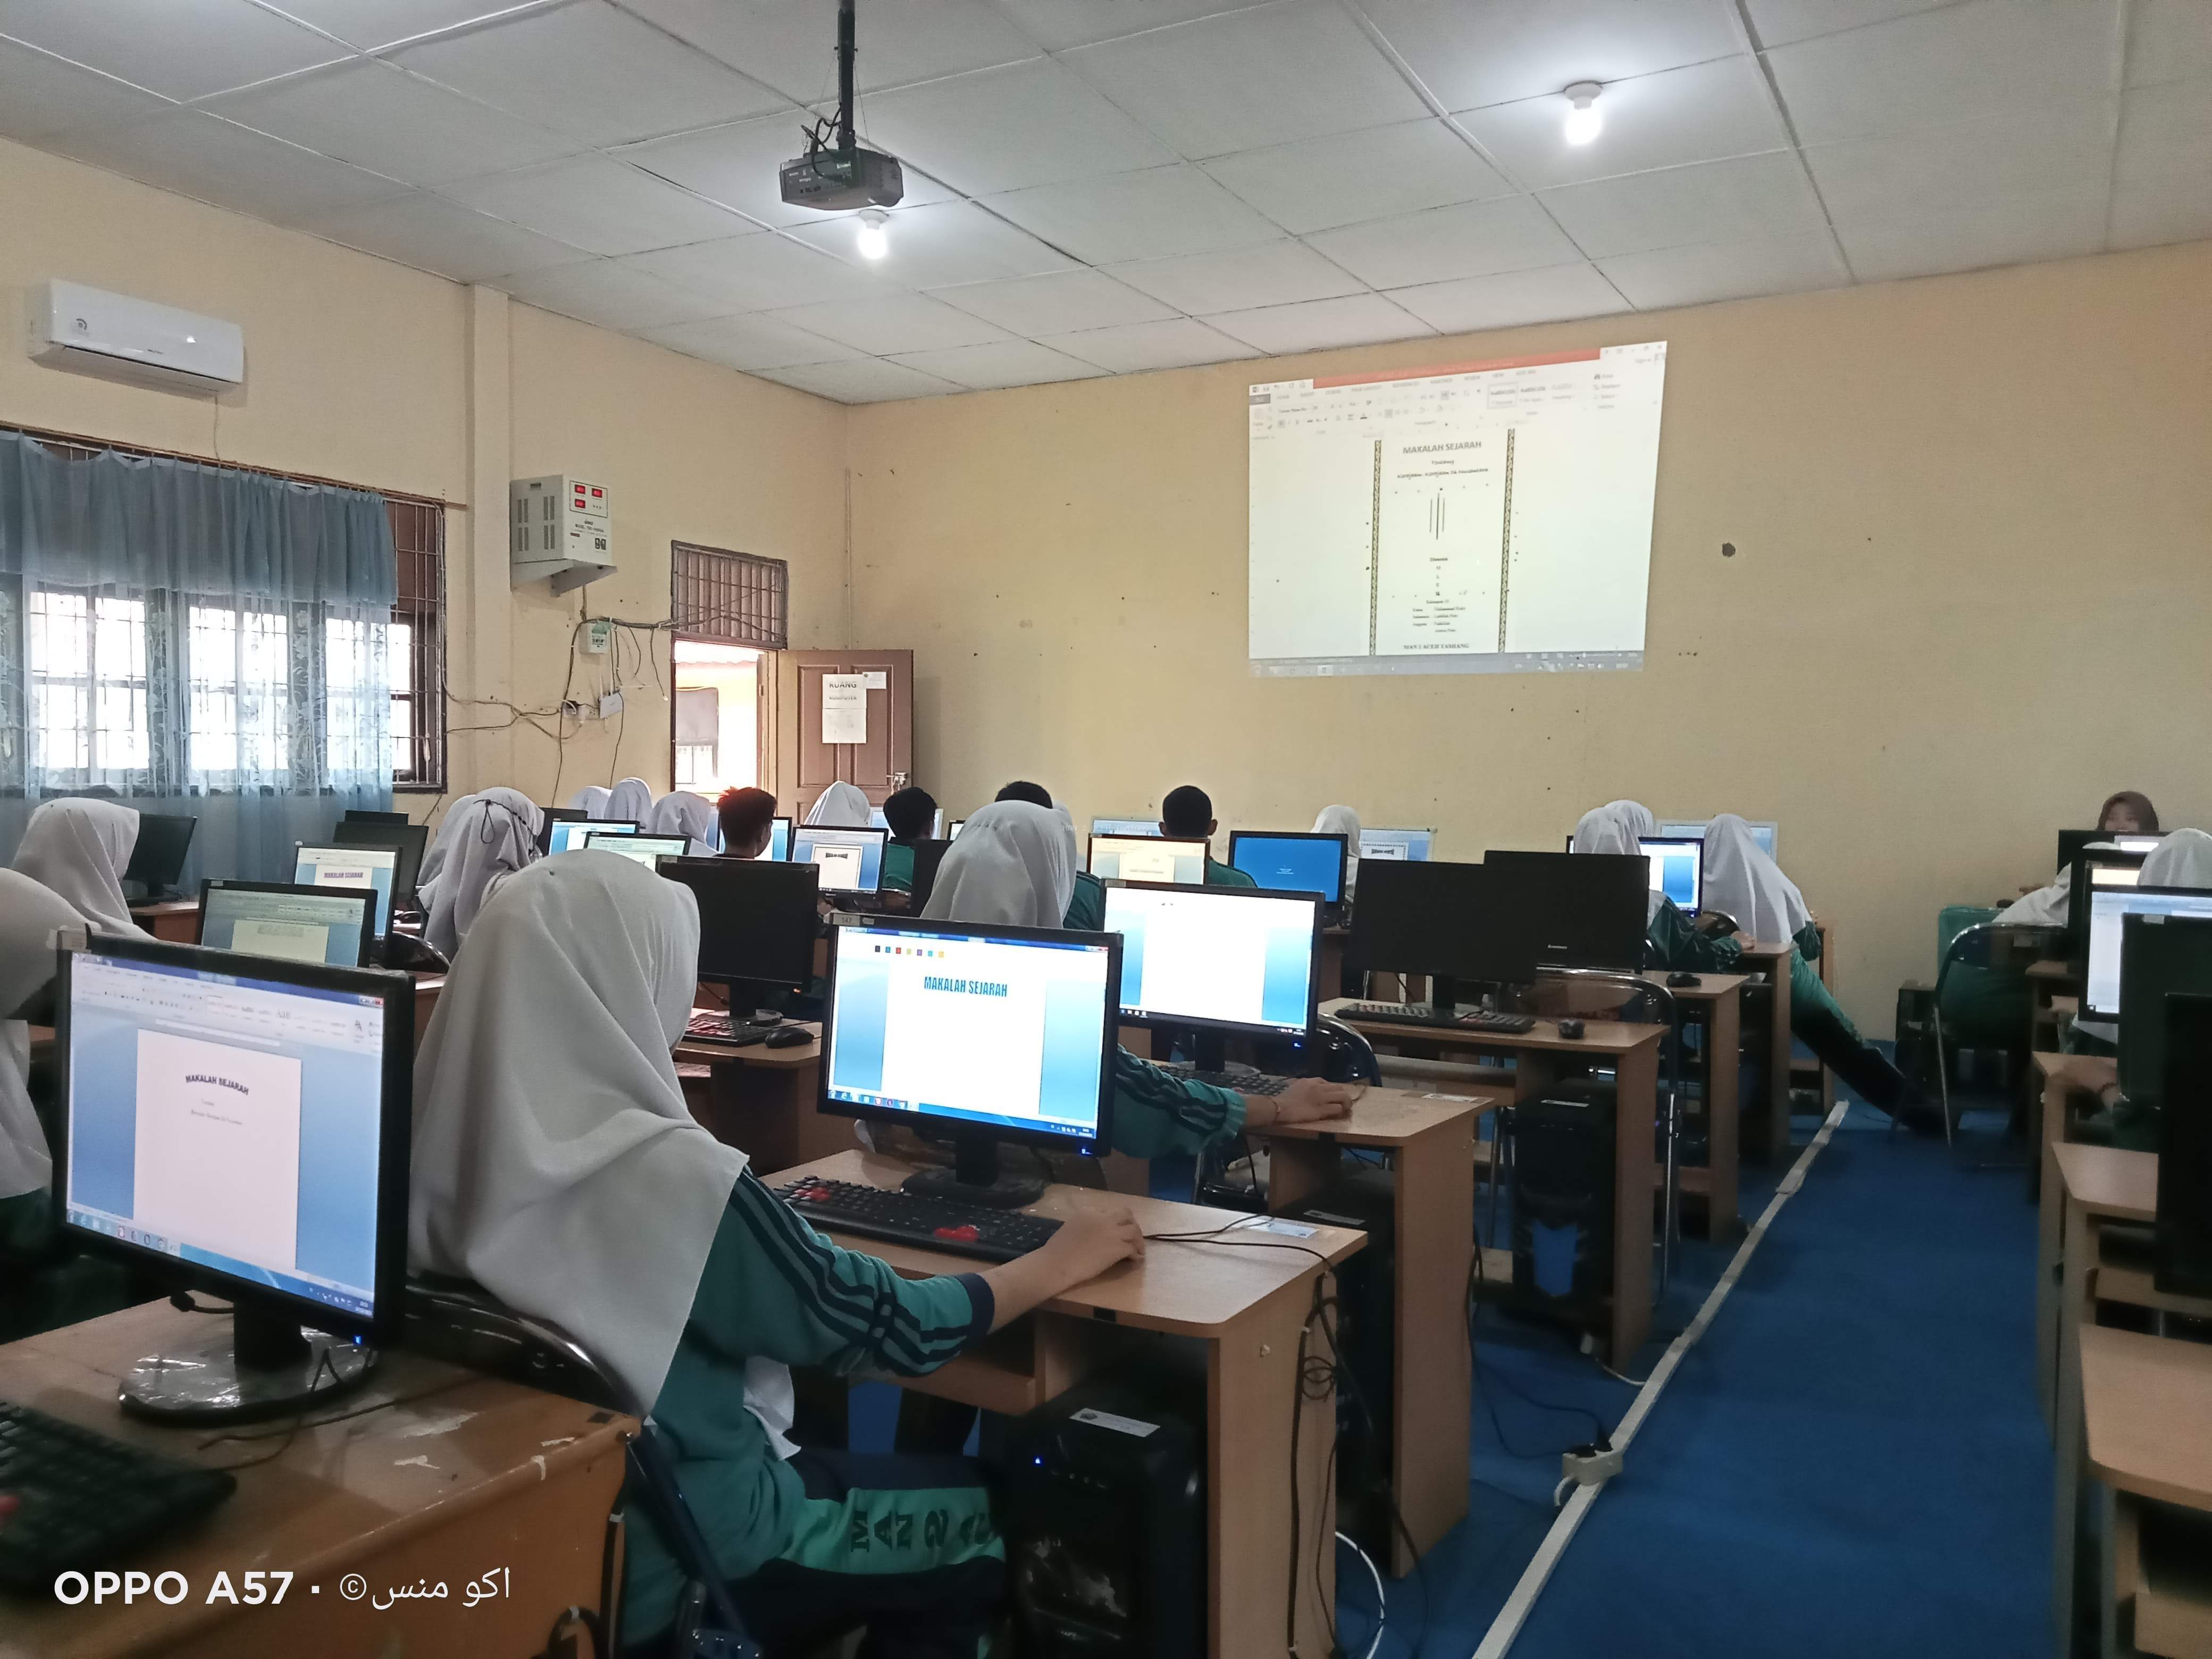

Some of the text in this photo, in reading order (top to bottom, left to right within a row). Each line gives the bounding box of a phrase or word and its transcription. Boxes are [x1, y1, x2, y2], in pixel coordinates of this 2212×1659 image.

[1403, 441, 1482, 454] MAKALAH SEJARAH
[924, 976, 1008, 998] MAKALAH SEJARAH
[185, 1074, 249, 1095] MAKALAH SEJARAH
[850, 1509, 914, 1553] MAN
[924, 1509, 949, 1548] 2
